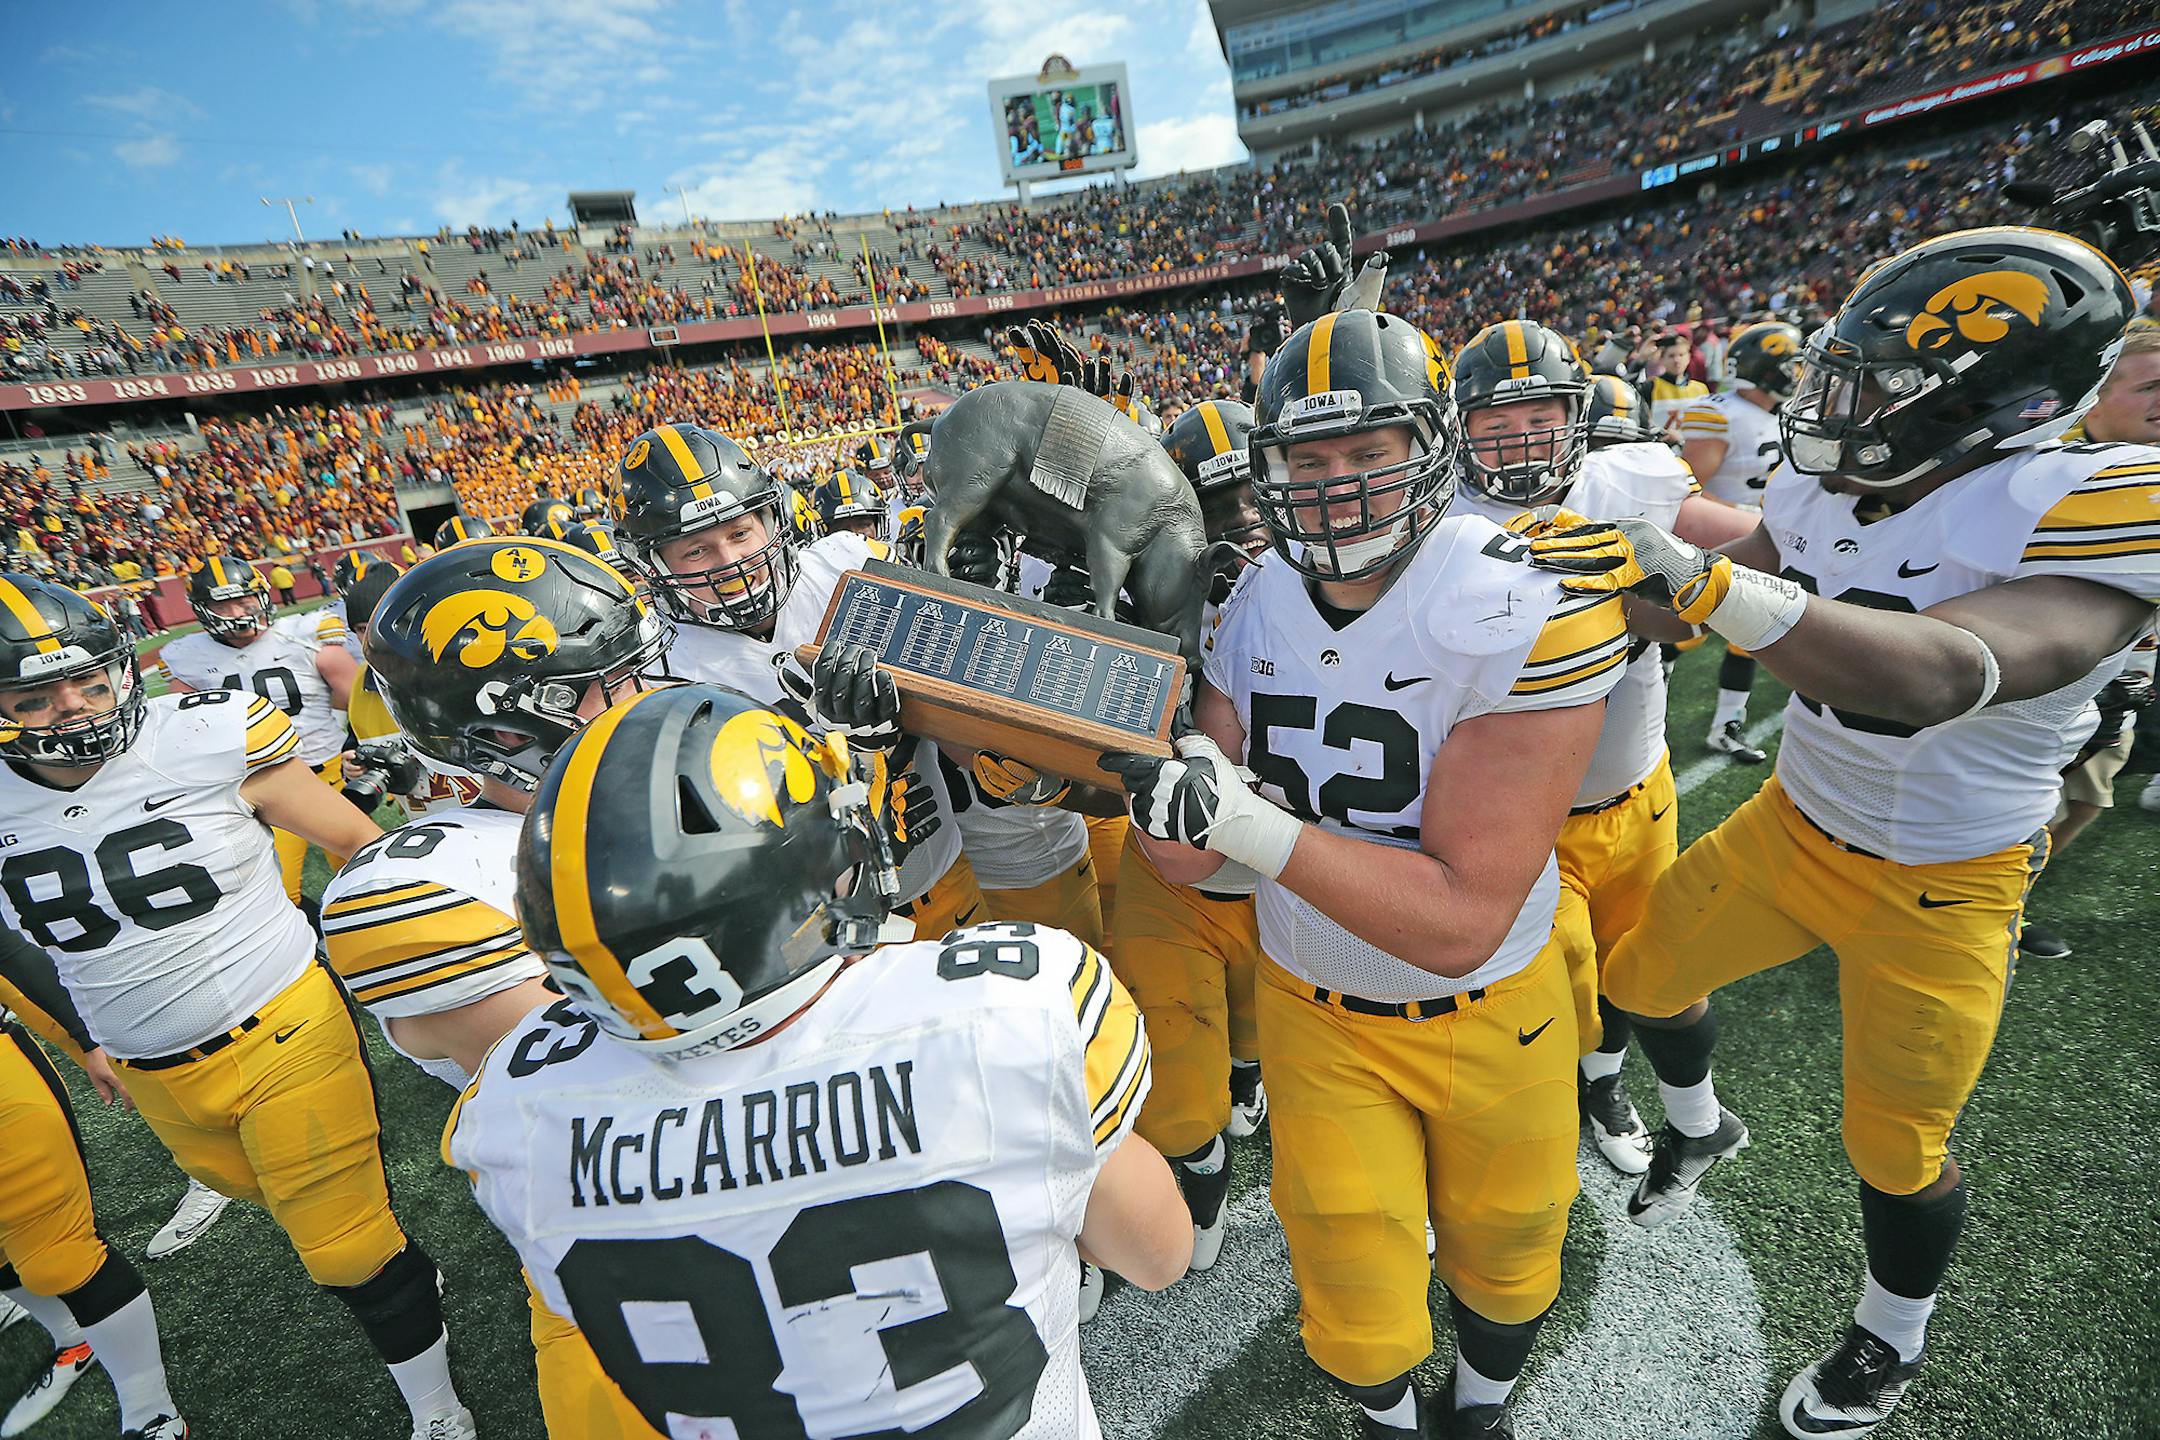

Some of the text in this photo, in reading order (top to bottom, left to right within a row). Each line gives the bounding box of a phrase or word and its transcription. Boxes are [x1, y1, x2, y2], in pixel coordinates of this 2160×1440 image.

[806, 314, 836, 328] 1904
[869, 308, 898, 323] 1934
[929, 301, 956, 317] 1935
[987, 296, 1014, 312] 1936
[1045, 284, 1108, 301] NATIONAL
[1116, 264, 1230, 292] CHAMPIONSHIPS
[25, 338, 576, 405] 1933 1934 1935 1937 1938 1940 1941 1960 1967
[1304, 395, 1337, 411] IOWA
[1215, 454, 1241, 468] IOWA
[694, 497, 722, 513] IOWA
[507, 549, 532, 579] ANF
[855, 586, 881, 604] M
[918, 601, 945, 620] M
[983, 618, 1010, 637] M
[1046, 635, 1073, 654] M
[40, 651, 72, 666] IOWA
[1111, 652, 1139, 672] M
[1248, 691, 1422, 839] 52
[1, 817, 224, 953] 86
[571, 1060, 922, 1208] McCARRON
[554, 1180, 1050, 1440] 83
